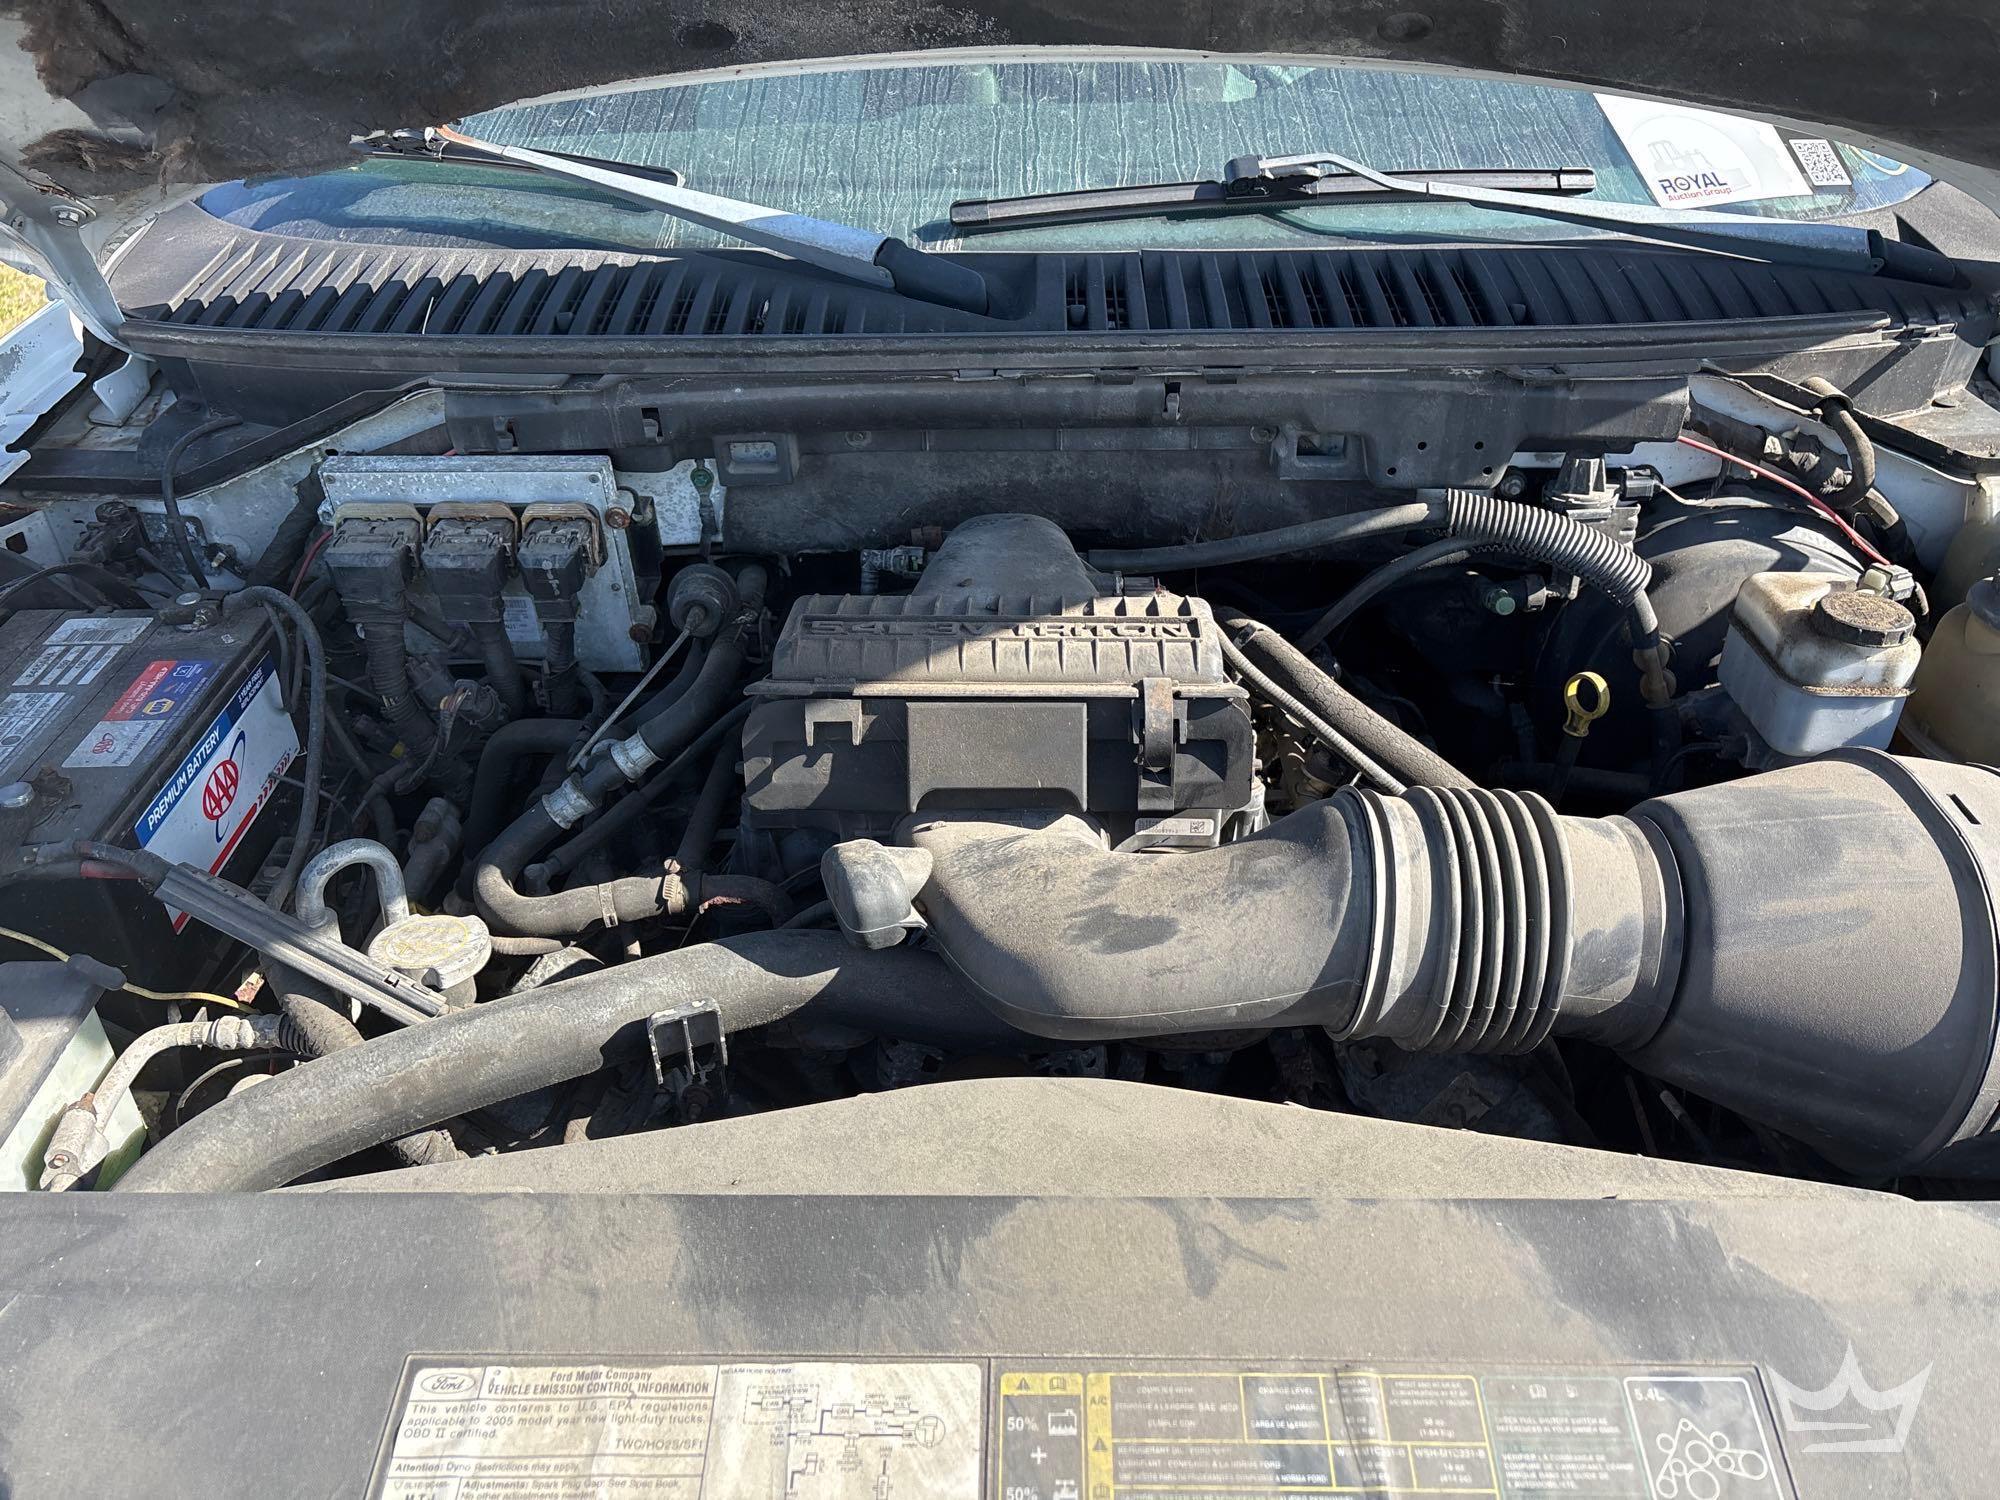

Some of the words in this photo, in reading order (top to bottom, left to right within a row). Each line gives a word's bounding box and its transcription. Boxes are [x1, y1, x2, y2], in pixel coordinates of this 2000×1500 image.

[1658, 172, 1728, 195] ROYAL
[1668, 190, 1703, 201] Auction
[1703, 187, 1732, 197] Group
[1008, 621, 1192, 638] TRITON
[147, 772, 189, 830] PREMIUM
[186, 726, 222, 780] BATTERY
[203, 761, 239, 820] AAA
[550, 1371, 572, 1381] Ford
[575, 1371, 603, 1381] Motor
[606, 1369, 652, 1381] Company
[431, 1376, 466, 1391] Ford
[488, 1383, 530, 1395] VEHICLE
[533, 1383, 584, 1395] EMISSION
[587, 1382, 633, 1393] CONTROL
[637, 1382, 709, 1394] INFORMATION
[1634, 1387, 1665, 1401] 5.4L
[412, 1404, 437, 1414] This
[446, 1402, 487, 1414] vehicle
[495, 1403, 551, 1413] conforms
[559, 1403, 570, 1412] to
[609, 1401, 633, 1411] EPA
[407, 1416, 466, 1427] applicable
[469, 1416, 481, 1425] to
[485, 1416, 514, 1426] 2005
[518, 1415, 553, 1426] model
[557, 1415, 580, 1427] year
[585, 1415, 607, 1424] new
[611, 1413, 665, 1426] light-duty
[1007, 1416, 1039, 1431] 50%
[404, 1429, 431, 1439] OBD
[435, 1428, 447, 1439] II
[446, 1462, 471, 1473] Dyno
[474, 1462, 529, 1473] Restrictions
[531, 1463, 551, 1473] may
[463, 1480, 529, 1491] Adjustments:
[531, 1480, 558, 1490] Spark
[562, 1479, 581, 1490] Plug
[607, 1478, 627, 1488] See
[1006, 1486, 1038, 1500] 50%
